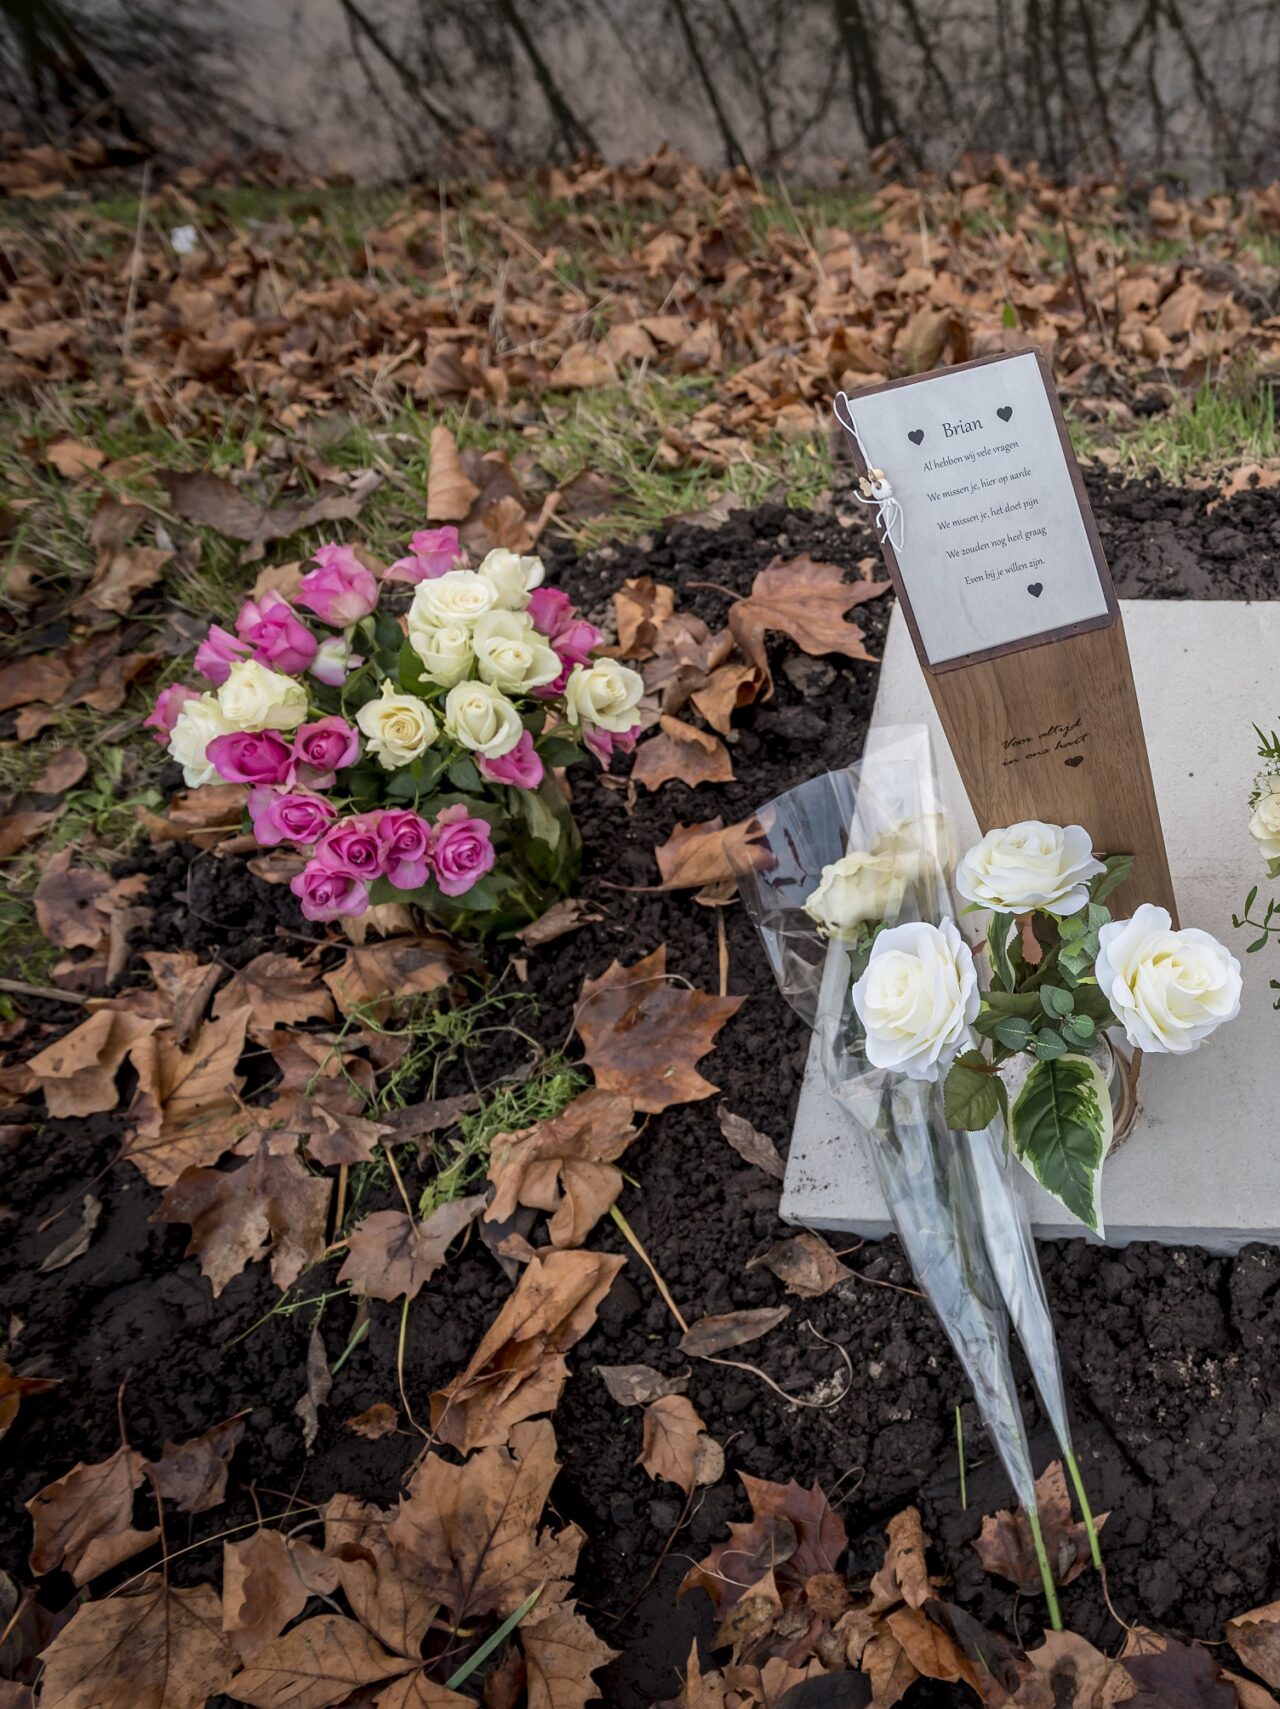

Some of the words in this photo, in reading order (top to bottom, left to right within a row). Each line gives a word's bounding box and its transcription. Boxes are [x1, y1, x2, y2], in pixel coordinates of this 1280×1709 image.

[941, 419, 984, 438] Brian
[923, 460, 933, 473] Al
[933, 455, 964, 470] hebben
[963, 451, 977, 463] wij
[976, 445, 992, 458] vele
[992, 440, 1020, 454] vragen
[926, 491, 941, 503] We
[942, 484, 970, 499] missen
[968, 481, 981, 495] je,
[979, 477, 997, 489] hier
[998, 474, 1009, 485] op
[1009, 466, 1032, 482] aarde
[936, 519, 951, 531] We
[952, 513, 979, 528] missen
[978, 510, 990, 523] je,
[989, 506, 1004, 517] het
[1004, 501, 1022, 513] doet
[1022, 497, 1040, 511] pijn
[946, 547, 960, 559] We
[961, 541, 990, 556] zouden
[990, 536, 1008, 548] nog
[1006, 529, 1024, 544] heel
[1024, 526, 1048, 541] graag
[964, 574, 984, 586] Even
[984, 569, 997, 581] bij
[996, 567, 1005, 580] je
[1004, 561, 1028, 574] willen
[1029, 557, 1046, 570] zijn.
[1001, 736, 1033, 750] Voor
[1038, 717, 1082, 739] altijd
[1001, 758, 1021, 767] in
[1025, 748, 1050, 760] ons
